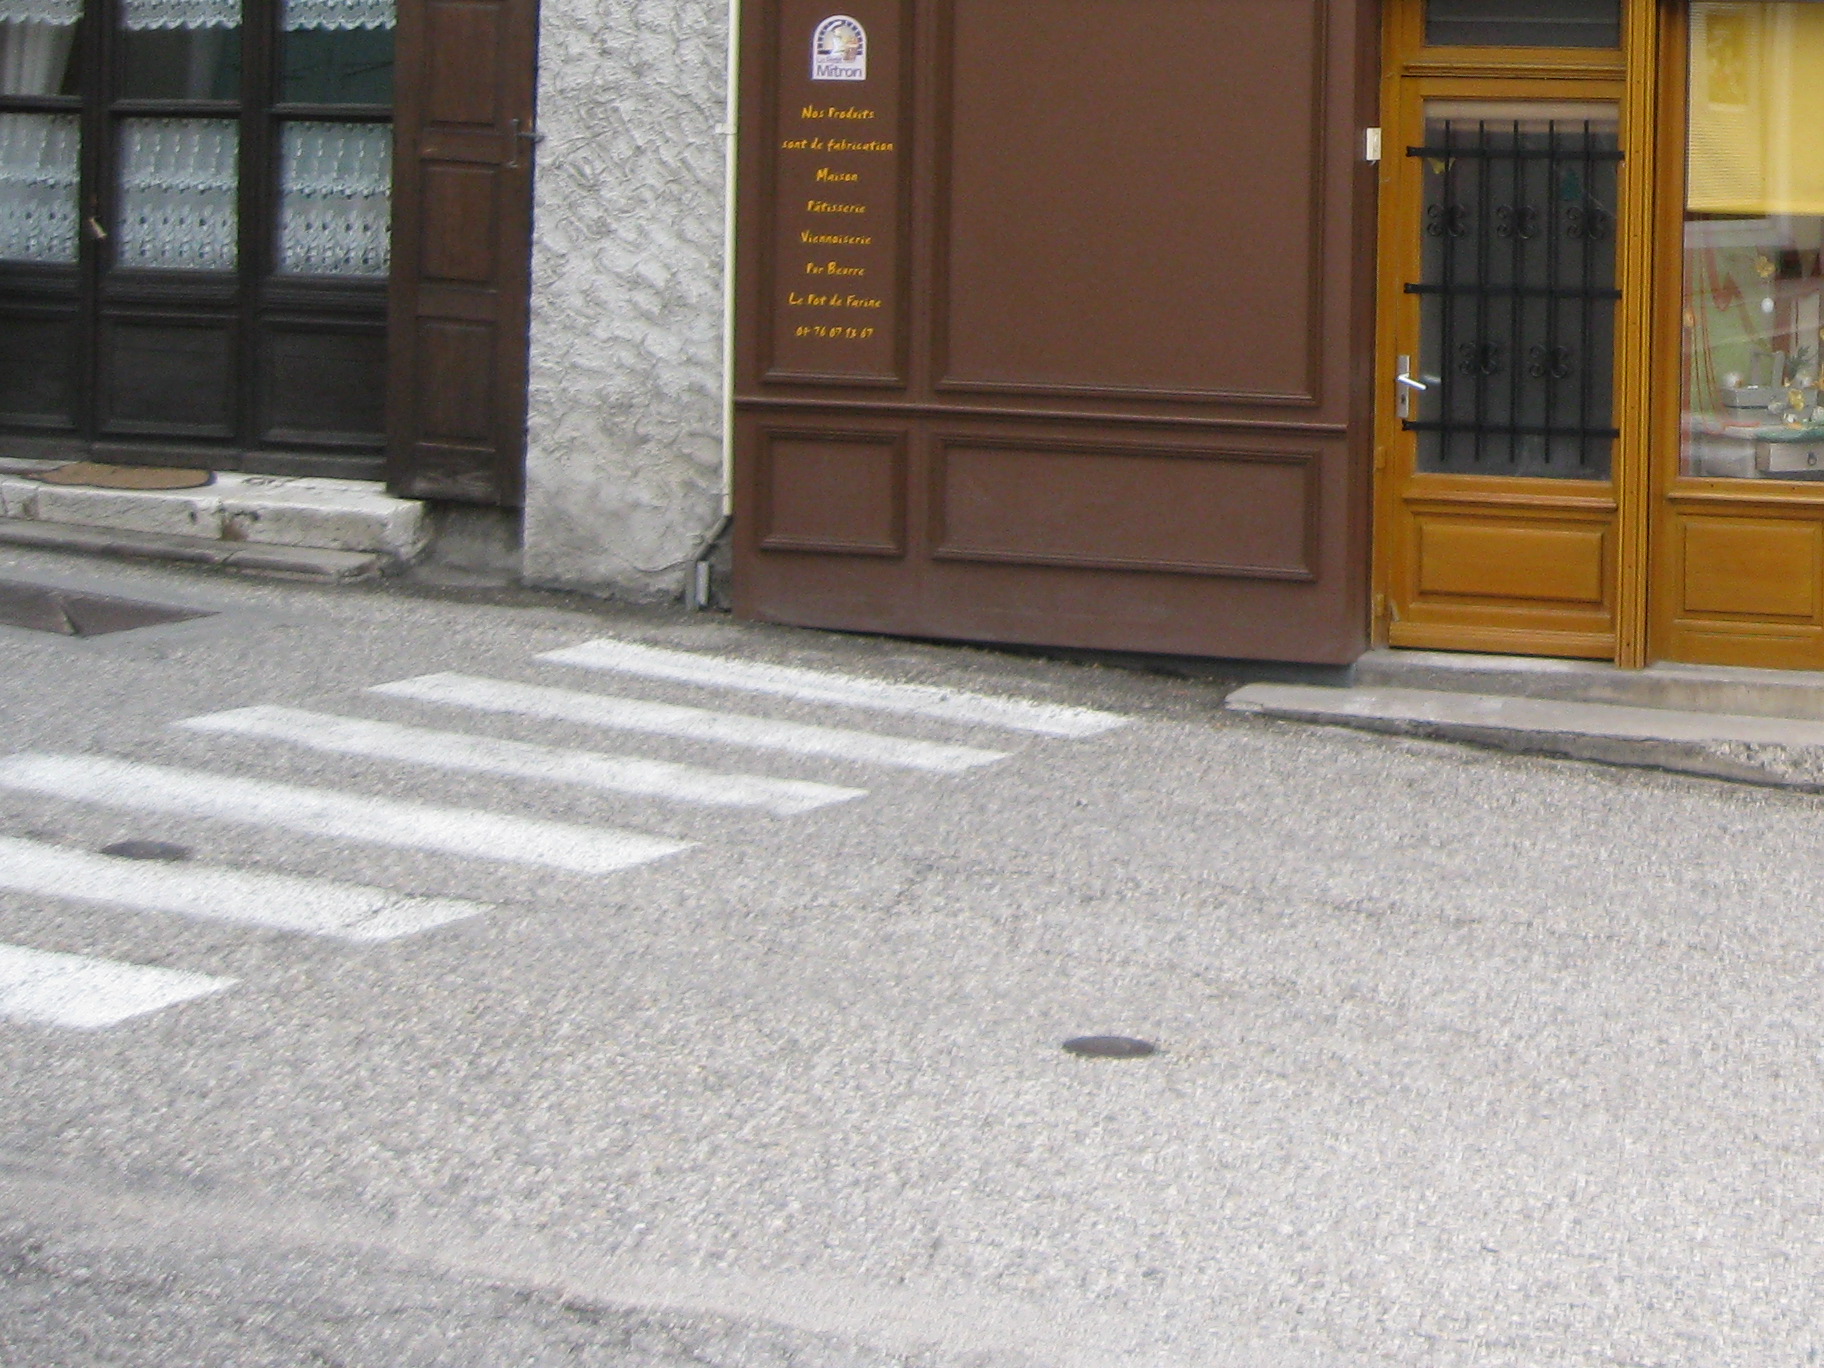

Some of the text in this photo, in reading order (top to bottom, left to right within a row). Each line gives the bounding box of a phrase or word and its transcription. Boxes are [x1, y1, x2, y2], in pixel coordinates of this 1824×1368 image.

[816, 64, 862, 78] Mitron
[801, 104, 875, 119] Nos Produits
[782, 137, 893, 151] sont de fabrication
[816, 167, 858, 182] Maison
[807, 199, 866, 213] Pâtisserie
[801, 230, 872, 244] Viennoiserie
[806, 261, 865, 276] Pur Beurre
[789, 291, 882, 308] Le Pot de Farine
